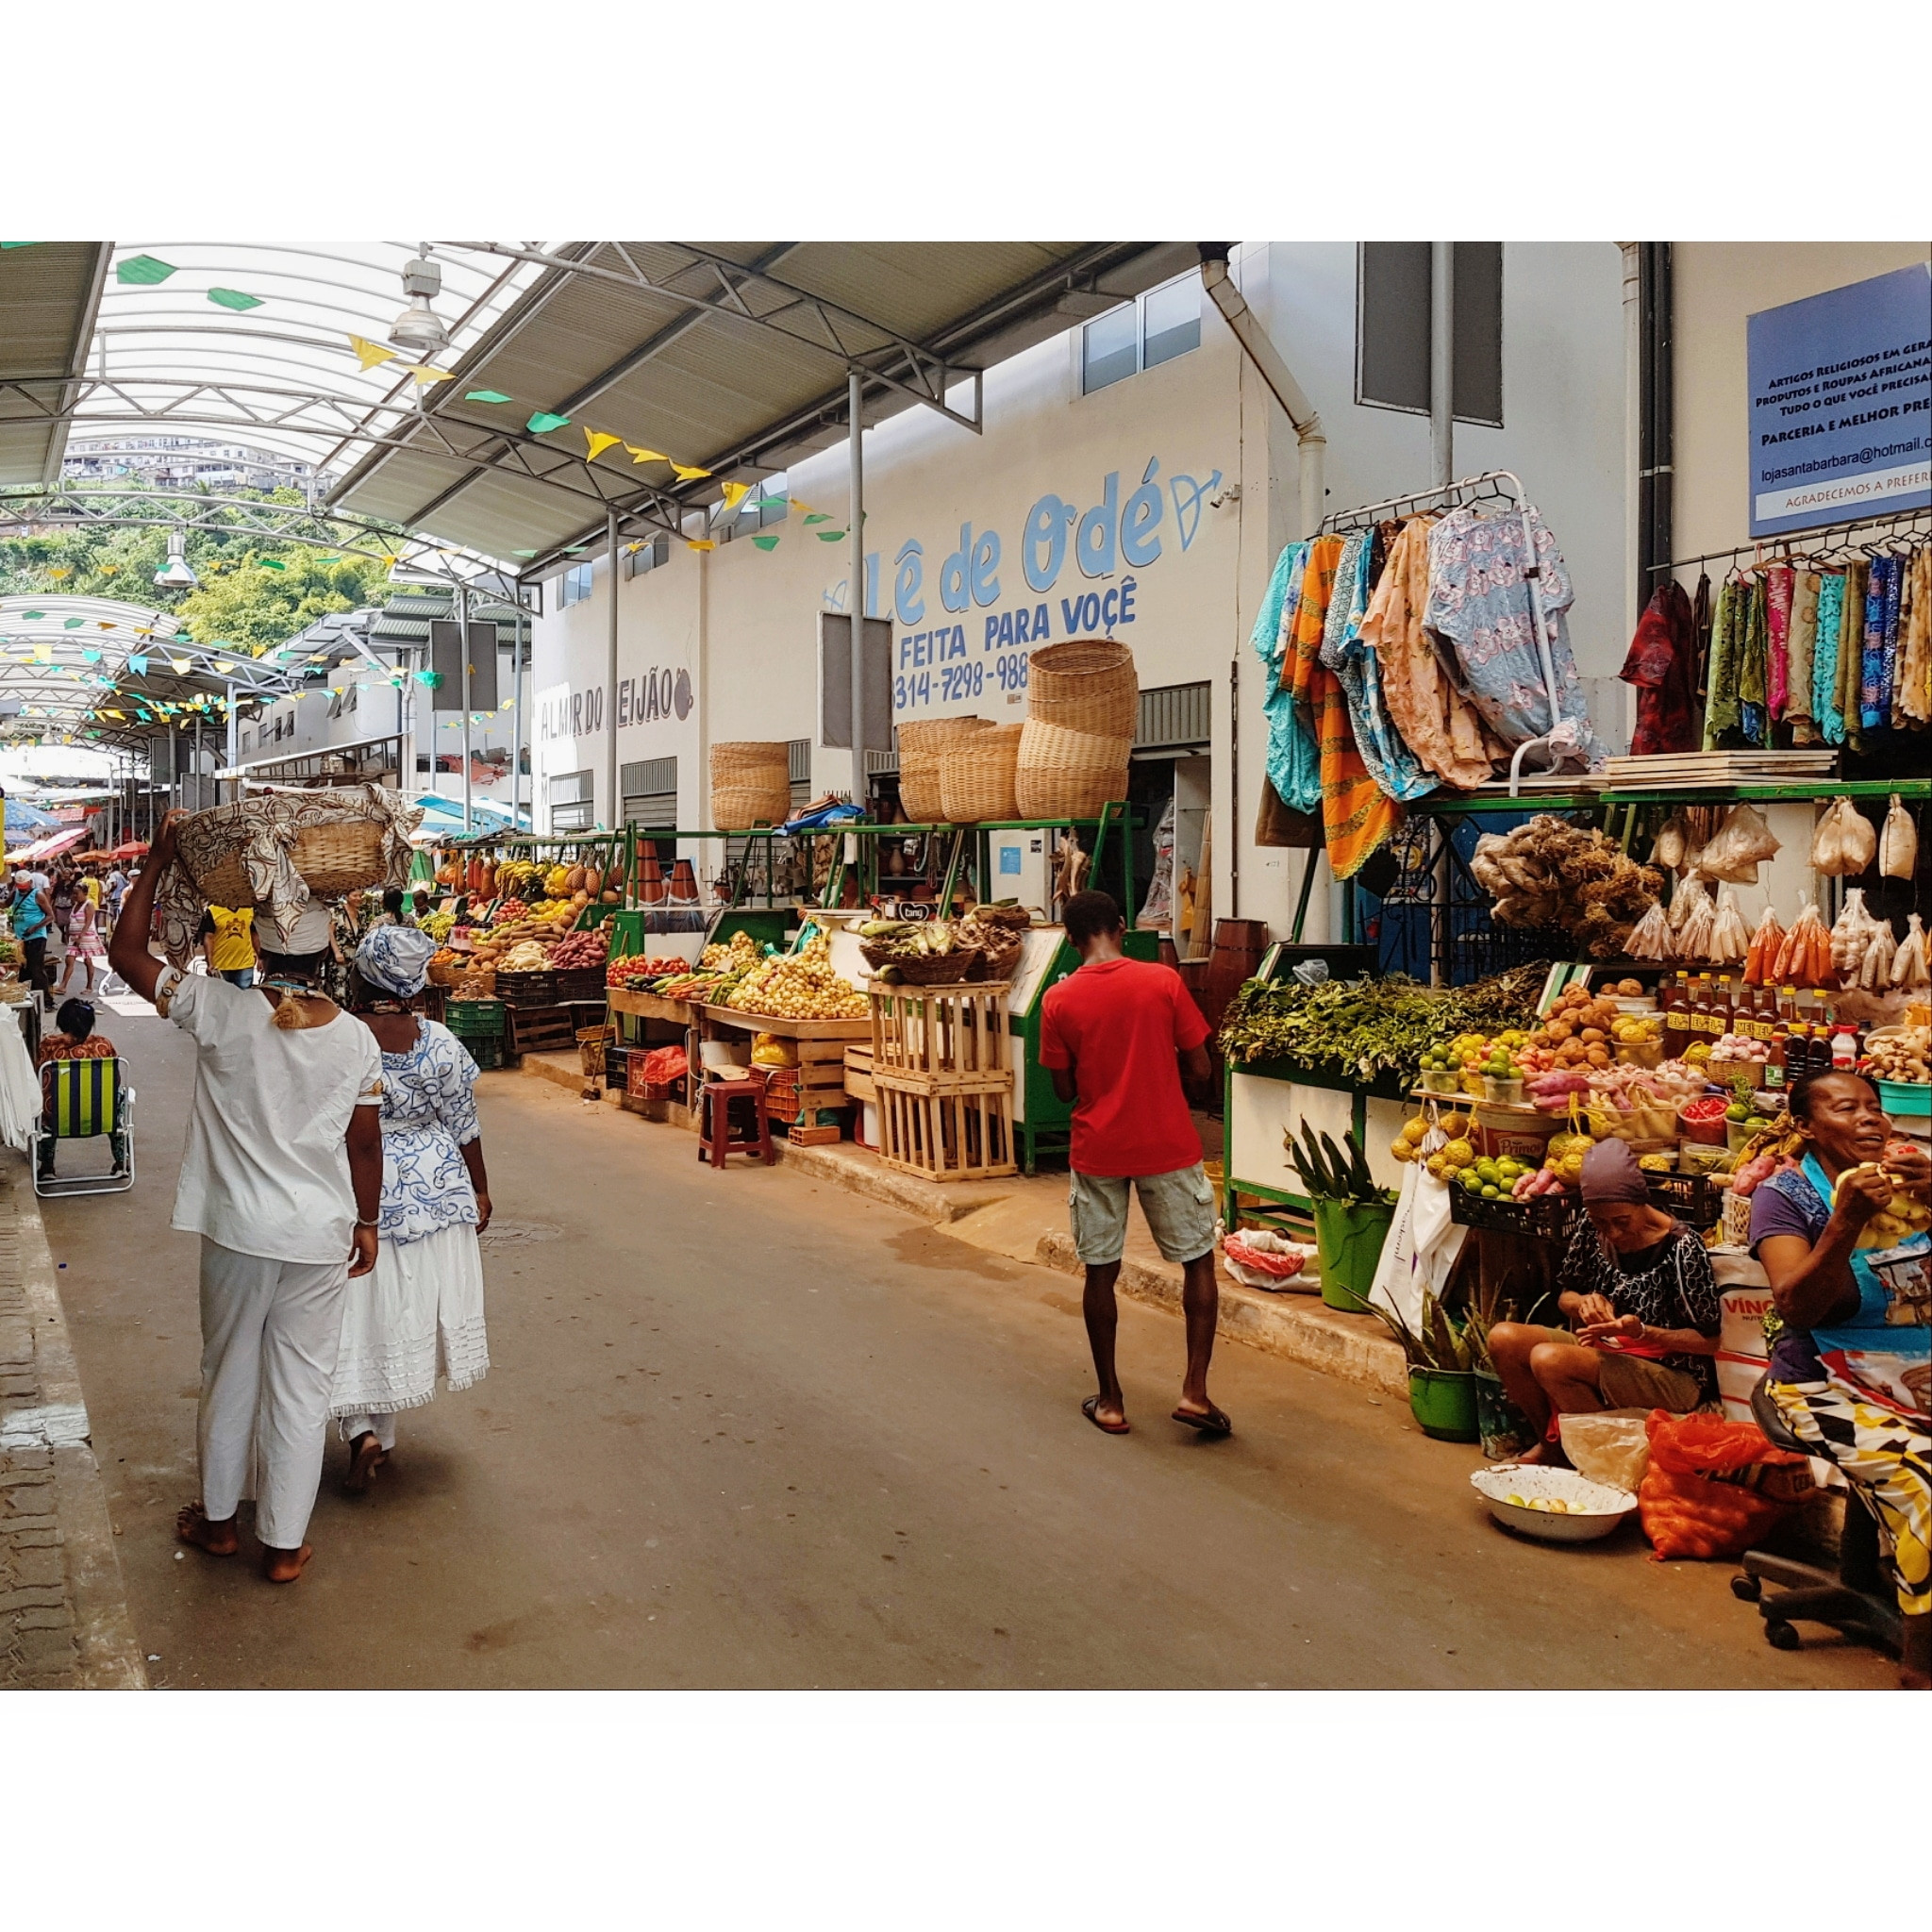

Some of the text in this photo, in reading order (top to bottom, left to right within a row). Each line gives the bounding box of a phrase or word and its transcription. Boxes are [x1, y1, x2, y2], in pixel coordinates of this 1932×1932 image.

[1883, 348, 1900, 360] EM
[1756, 384, 1811, 408] PRODUTOS
[1814, 384, 1820, 393] E
[1869, 357, 1931, 379] AFRICANA
[1780, 372, 1931, 416] TUDO O QUE VOCÊ PRECISA
[1761, 424, 1825, 446] PARCERIA
[1828, 420, 1836, 431] E
[1839, 406, 1899, 428] MELHOR
[1786, 471, 1931, 508] AGRADECEMOS A PREFER
[941, 521, 1002, 613] de
[1022, 456, 1164, 592] Odé
[899, 575, 1137, 671] FEITA PARA VOÇÊ
[541, 666, 673, 742] ALMIR DO EIJÃO
[905, 908, 923, 919] tang
[1738, 1022, 1755, 1033] MEL
